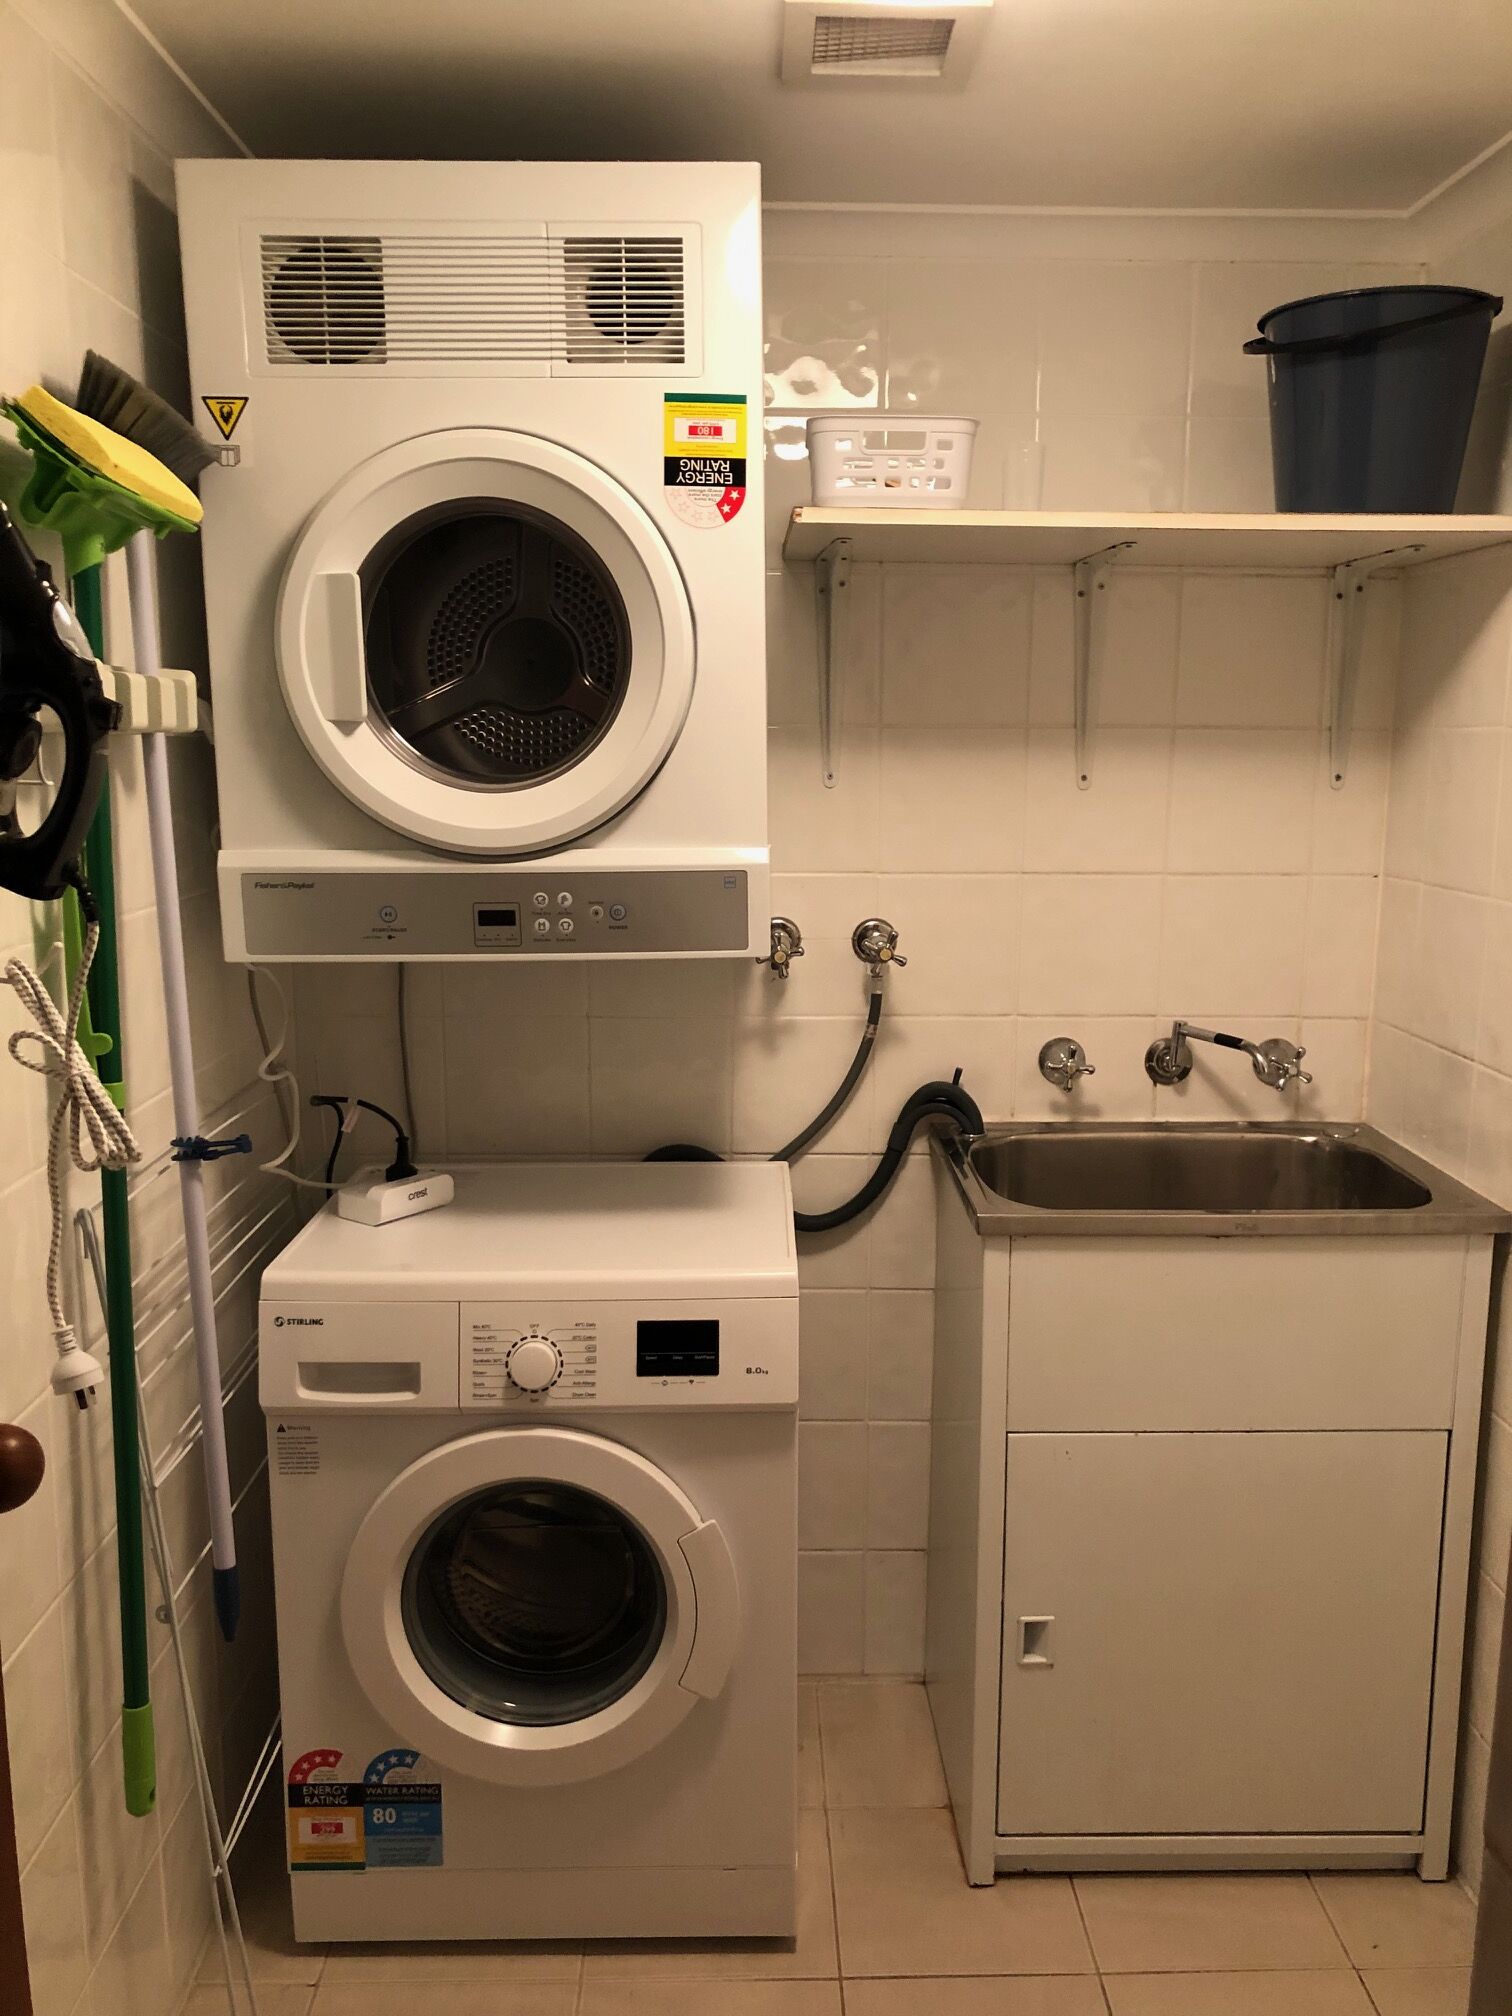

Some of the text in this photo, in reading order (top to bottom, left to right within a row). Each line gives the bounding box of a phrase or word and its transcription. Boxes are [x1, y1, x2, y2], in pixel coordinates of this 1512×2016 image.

[697, 426, 714, 436] 180
[680, 459, 730, 472] RATING
[676, 472, 733, 484] ENERGY
[408, 1187, 428, 1200] crest
[302, 1786, 348, 1795] ENERGY
[402, 1787, 438, 1795] RATING
[304, 1795, 348, 1805] RATING
[372, 1808, 397, 1824] 80
